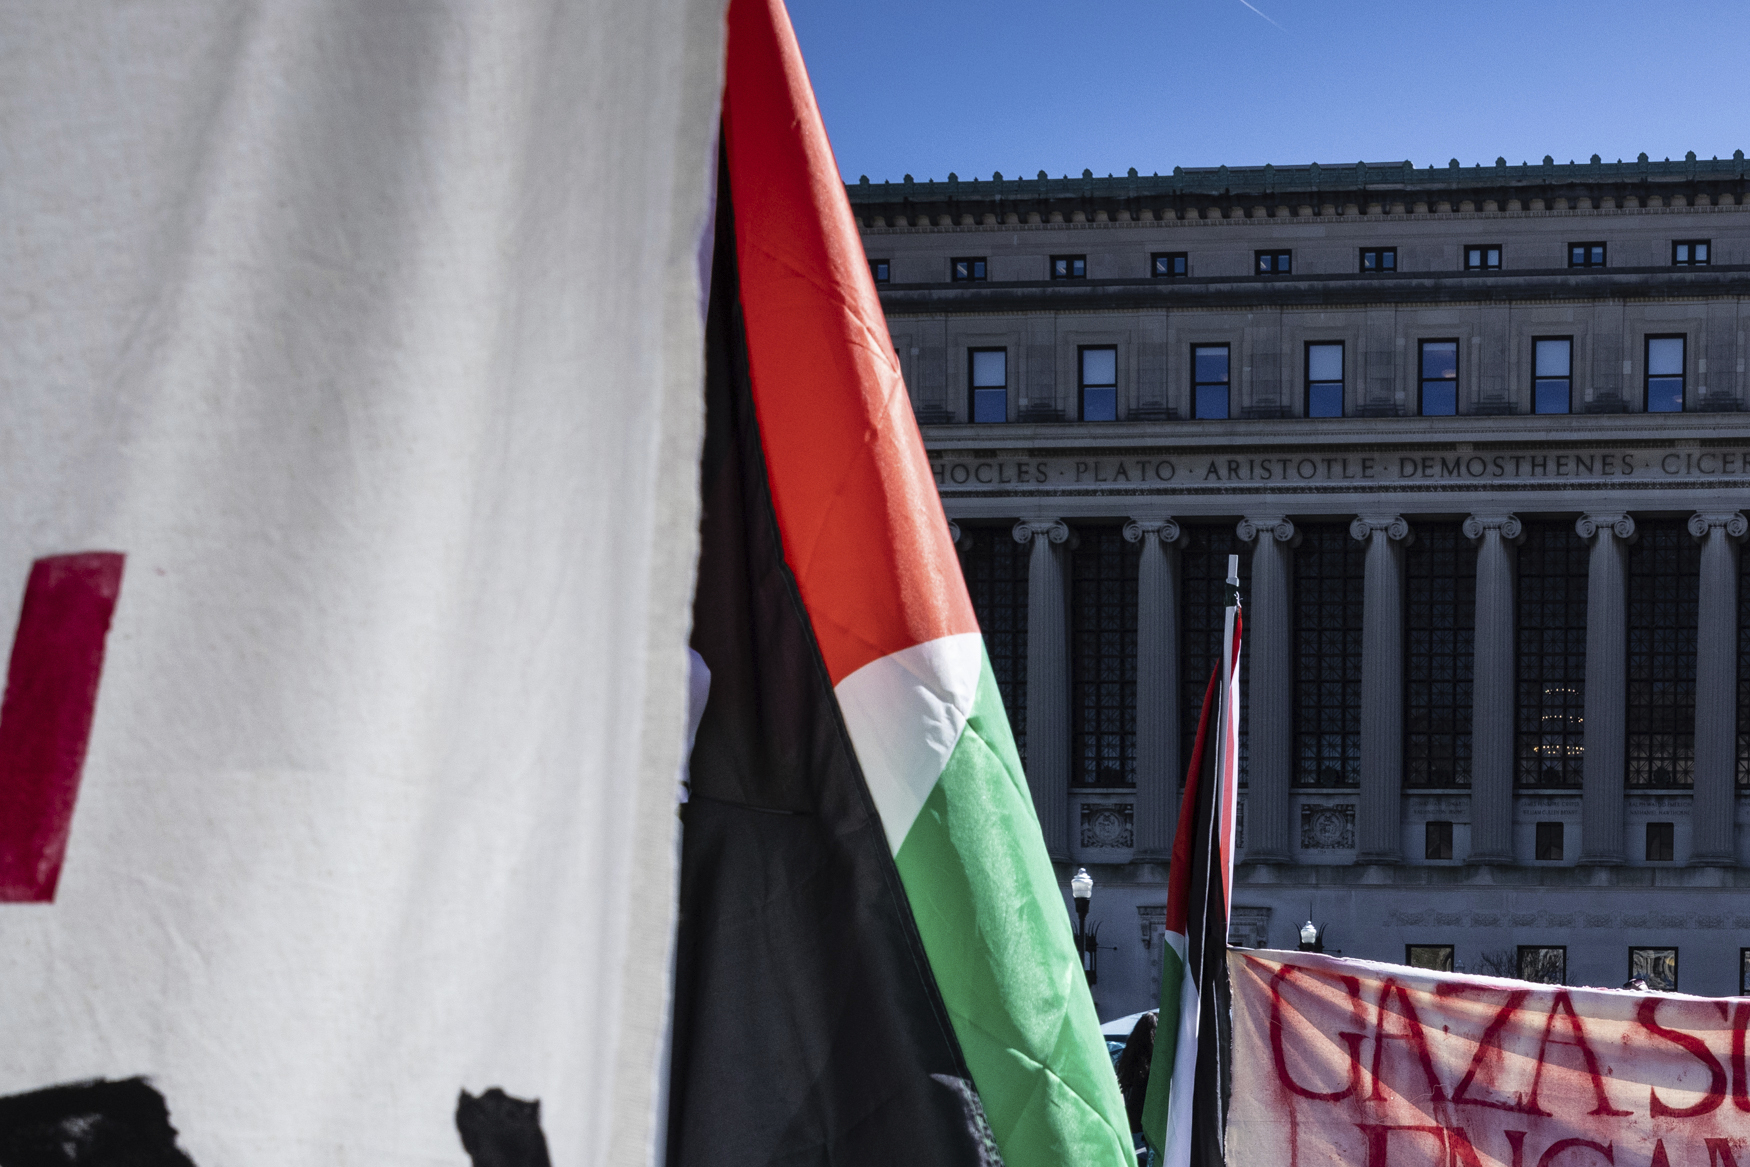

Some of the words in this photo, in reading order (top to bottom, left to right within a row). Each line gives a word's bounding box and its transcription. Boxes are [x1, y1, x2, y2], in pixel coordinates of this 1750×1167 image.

[932, 462, 1048, 485] HOCLES
[1075, 460, 1176, 483] PLATO
[1202, 456, 1376, 481] ARISTOTLE
[1399, 452, 1635, 479] DEMOSTHENES
[1269, 963, 1635, 1118] GAZA
